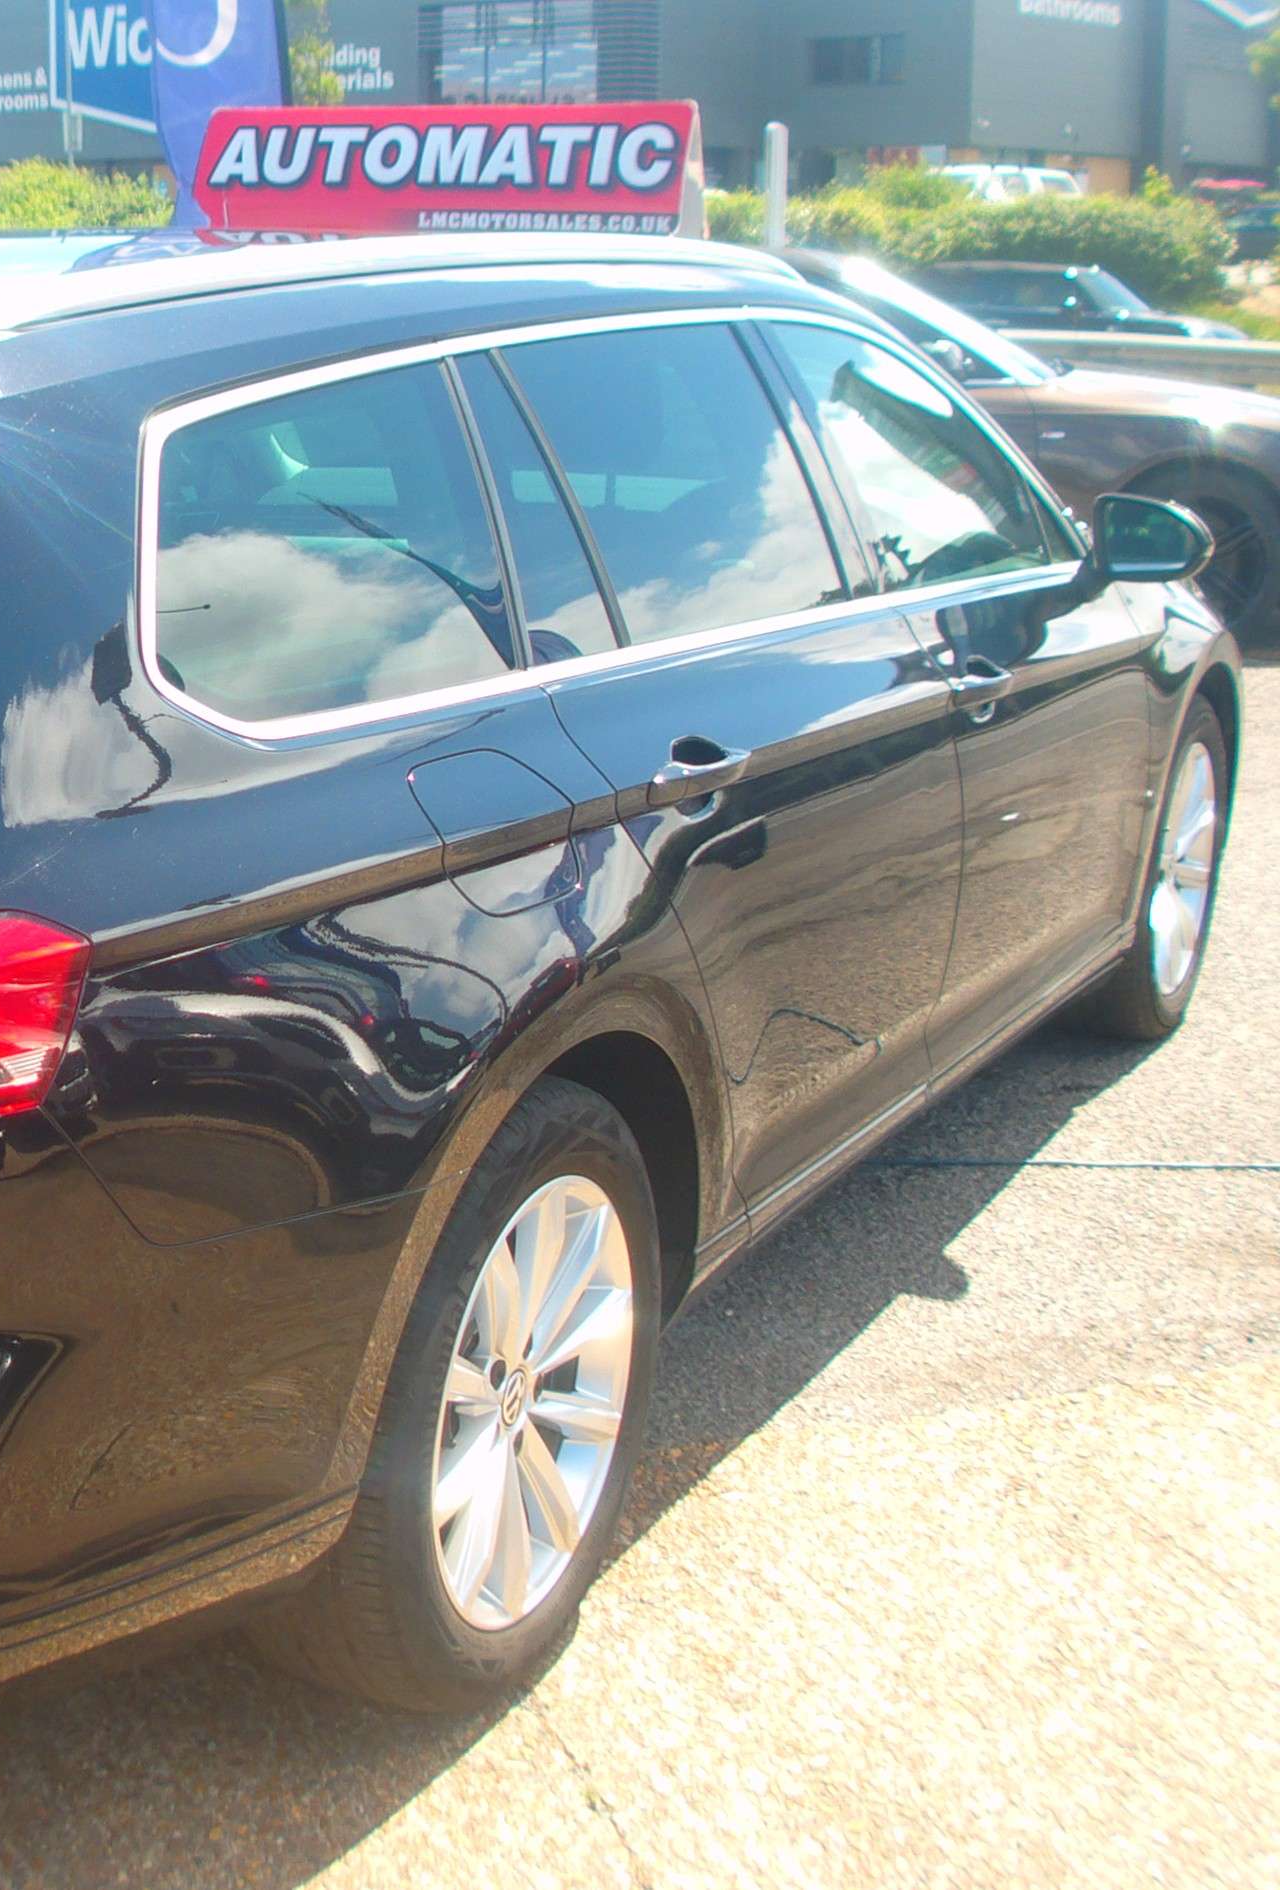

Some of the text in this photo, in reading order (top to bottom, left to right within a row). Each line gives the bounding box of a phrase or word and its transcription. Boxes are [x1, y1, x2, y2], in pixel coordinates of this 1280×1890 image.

[69, 5, 152, 69] Wic
[35, 66, 48, 88] &
[335, 67, 395, 90] erials
[208, 122, 675, 189] AUTOMATIC
[418, 211, 671, 234] LMCMOTORSALES.CO.UK
